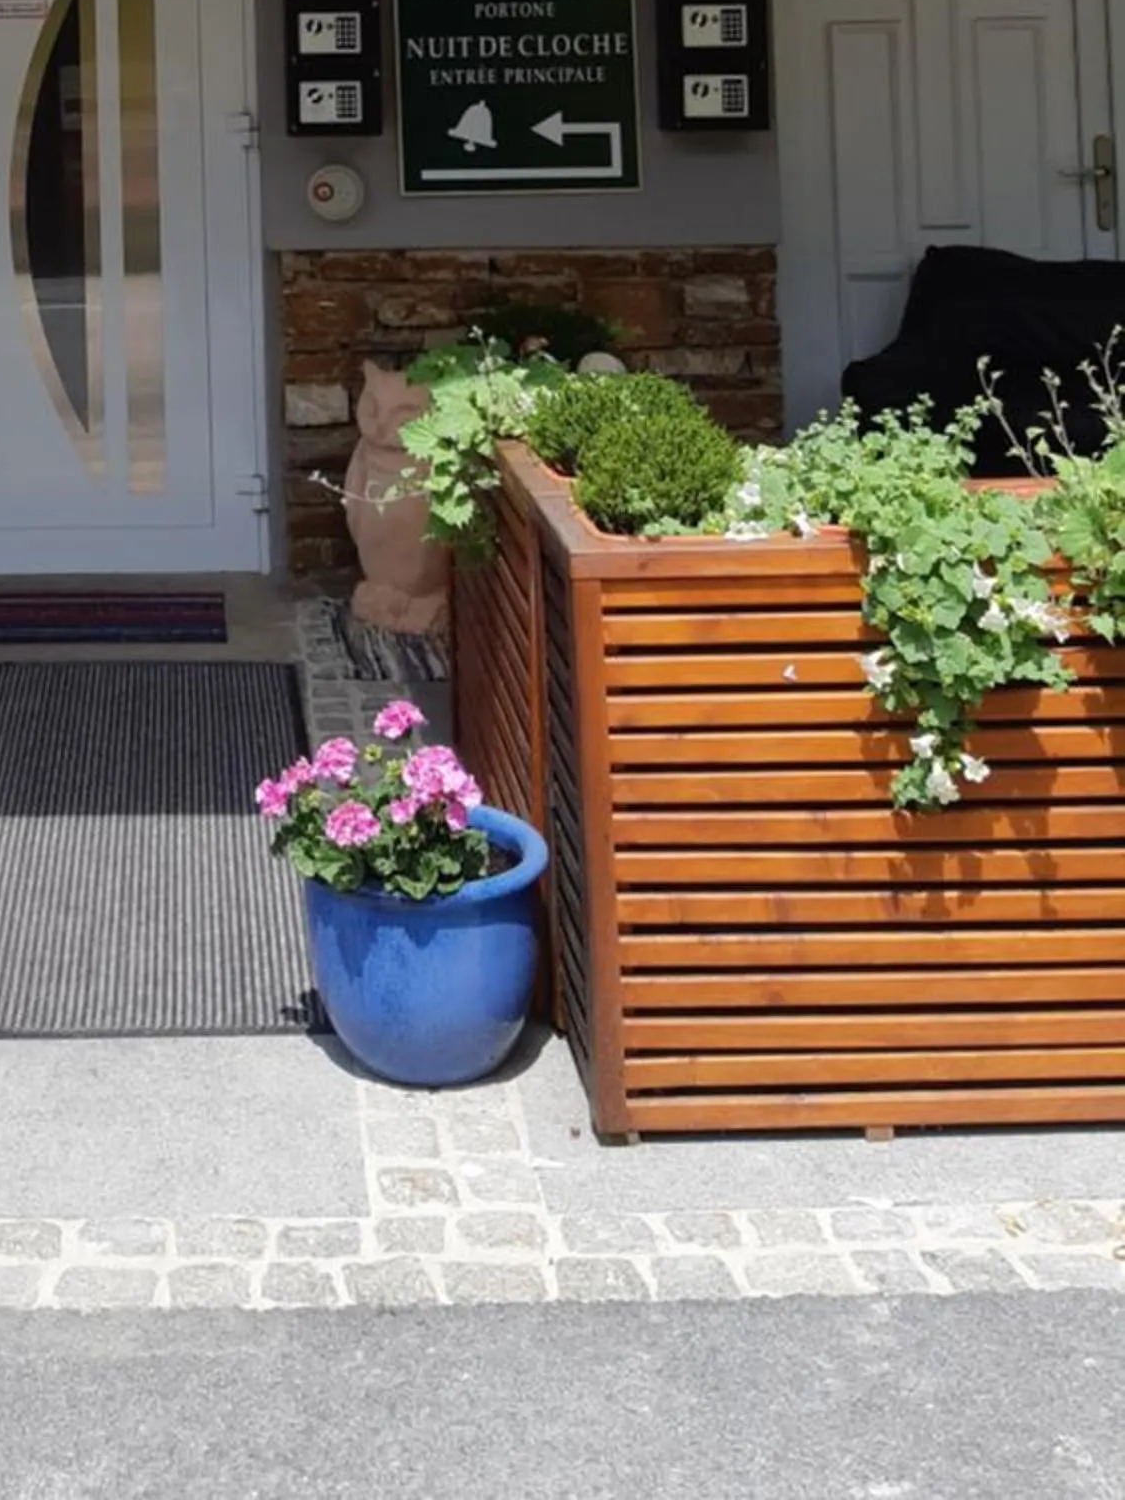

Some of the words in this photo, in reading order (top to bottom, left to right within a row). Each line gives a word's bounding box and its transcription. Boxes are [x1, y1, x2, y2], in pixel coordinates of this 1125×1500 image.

[475, 1, 555, 18] PORTONE
[407, 35, 473, 58] NUIT
[479, 35, 512, 57] DE
[517, 33, 628, 56] CLOCHE
[503, 66, 606, 84] PRINCIPALE
